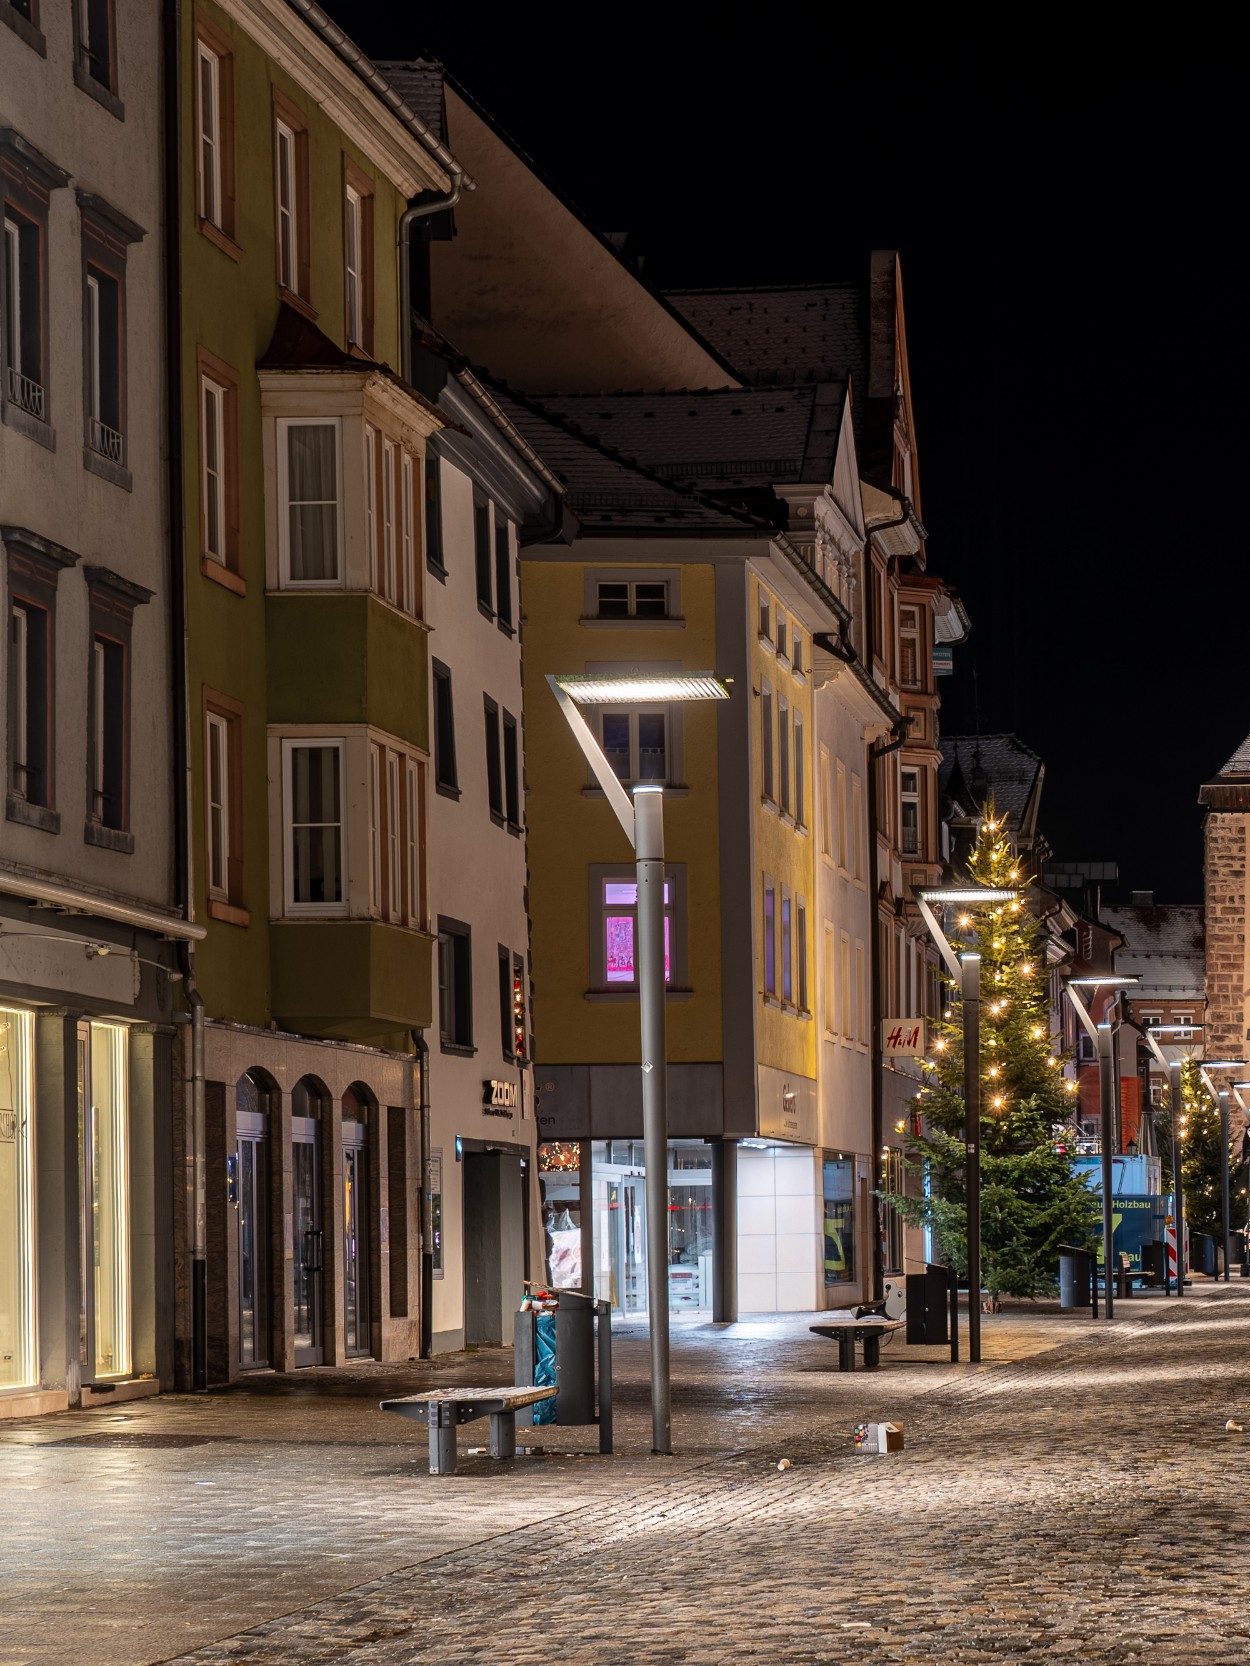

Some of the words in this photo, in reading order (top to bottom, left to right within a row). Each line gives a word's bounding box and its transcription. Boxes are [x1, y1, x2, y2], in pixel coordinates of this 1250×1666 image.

[886, 1026, 920, 1049] H&M
[489, 1080, 518, 1107] ZOOM
[1112, 1200, 1151, 1209] Holzbau
